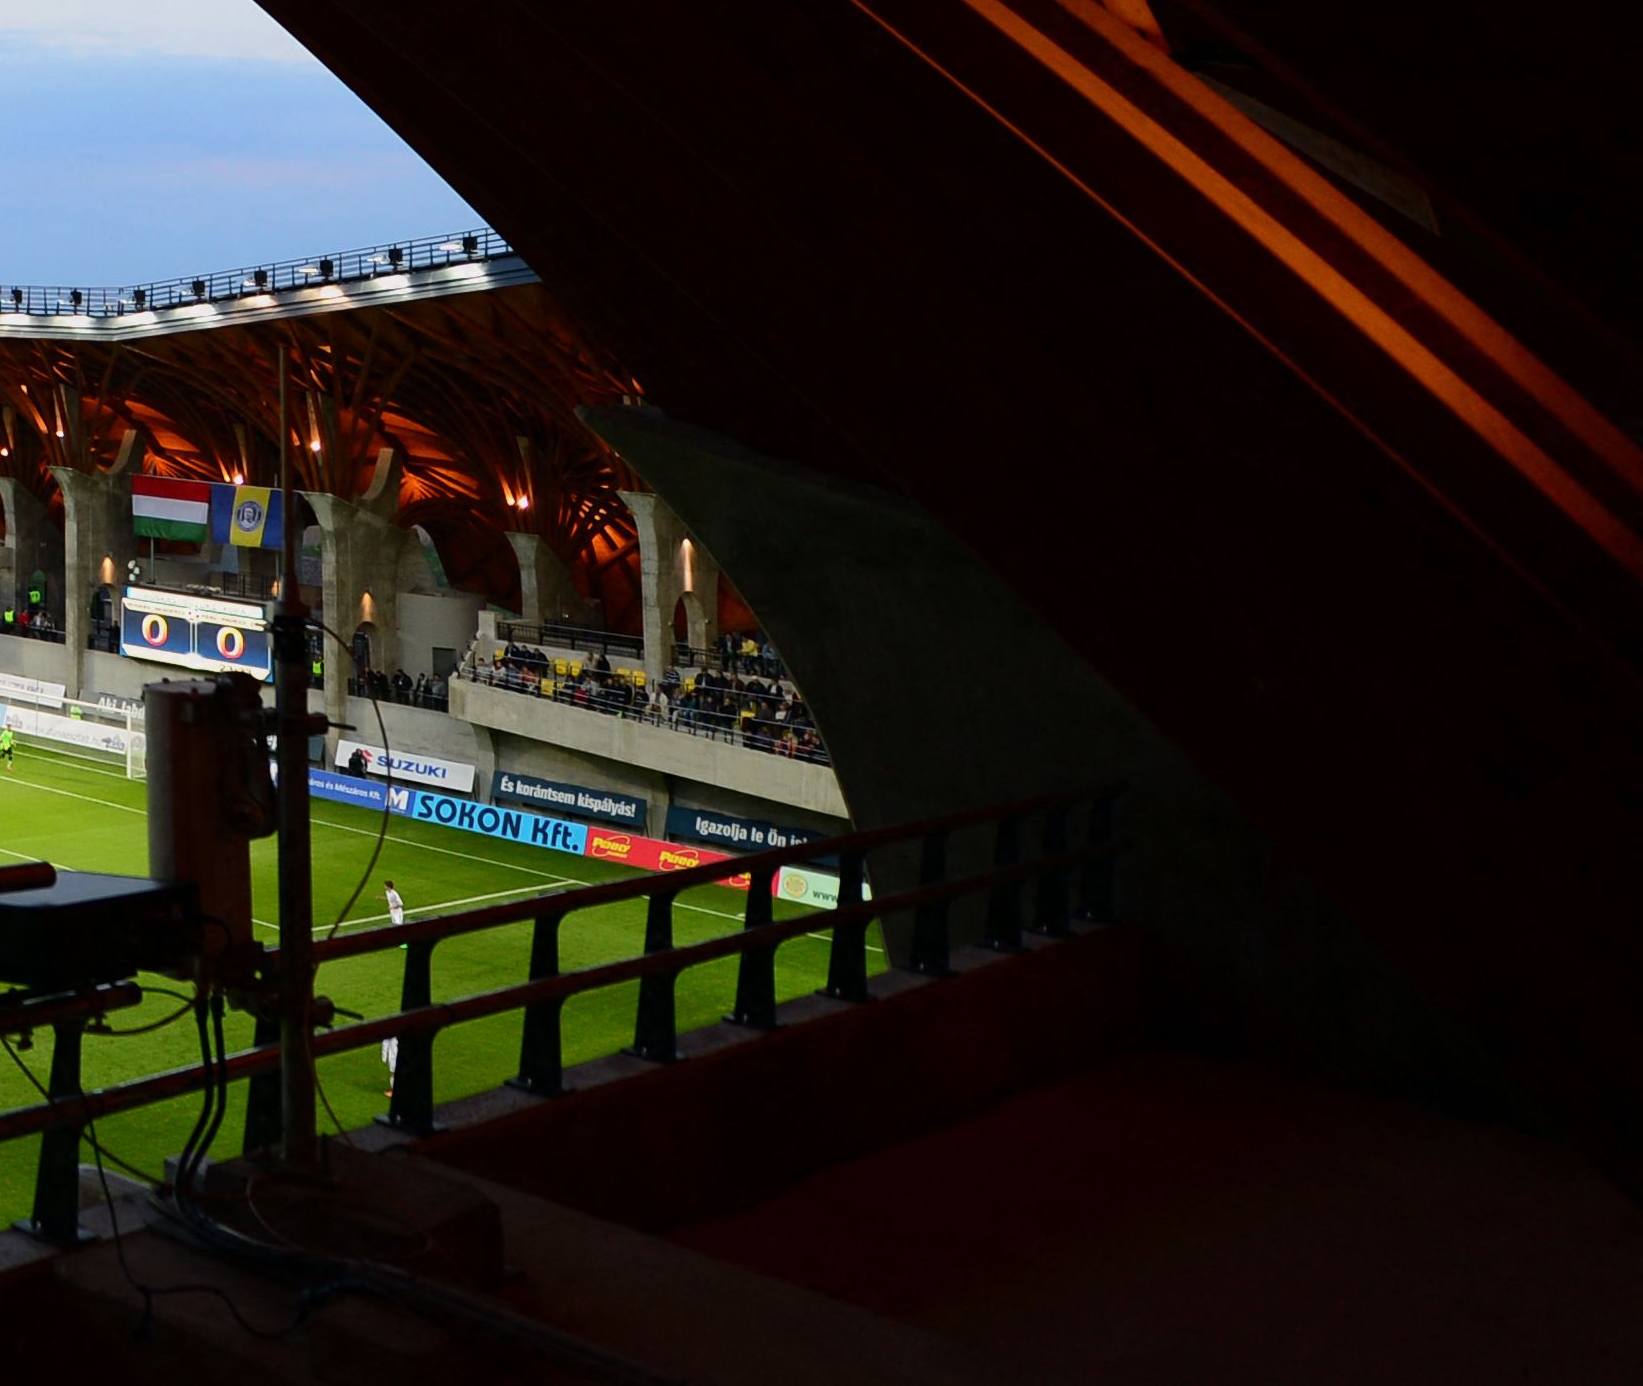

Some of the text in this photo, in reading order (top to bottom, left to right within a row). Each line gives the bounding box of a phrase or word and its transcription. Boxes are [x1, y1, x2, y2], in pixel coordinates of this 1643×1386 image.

[142, 614, 168, 646] 0
[217, 626, 244, 659] 0
[377, 755, 447, 779] SUZUKI
[335, 782, 368, 798] Mészáros
[500, 775, 636, 818] És korántsem kispályás!
[417, 795, 579, 851] SOKON Kft.
[695, 816, 747, 842] Igazolja
[751, 827, 764, 843] le
[768, 828, 787, 848] Ön
